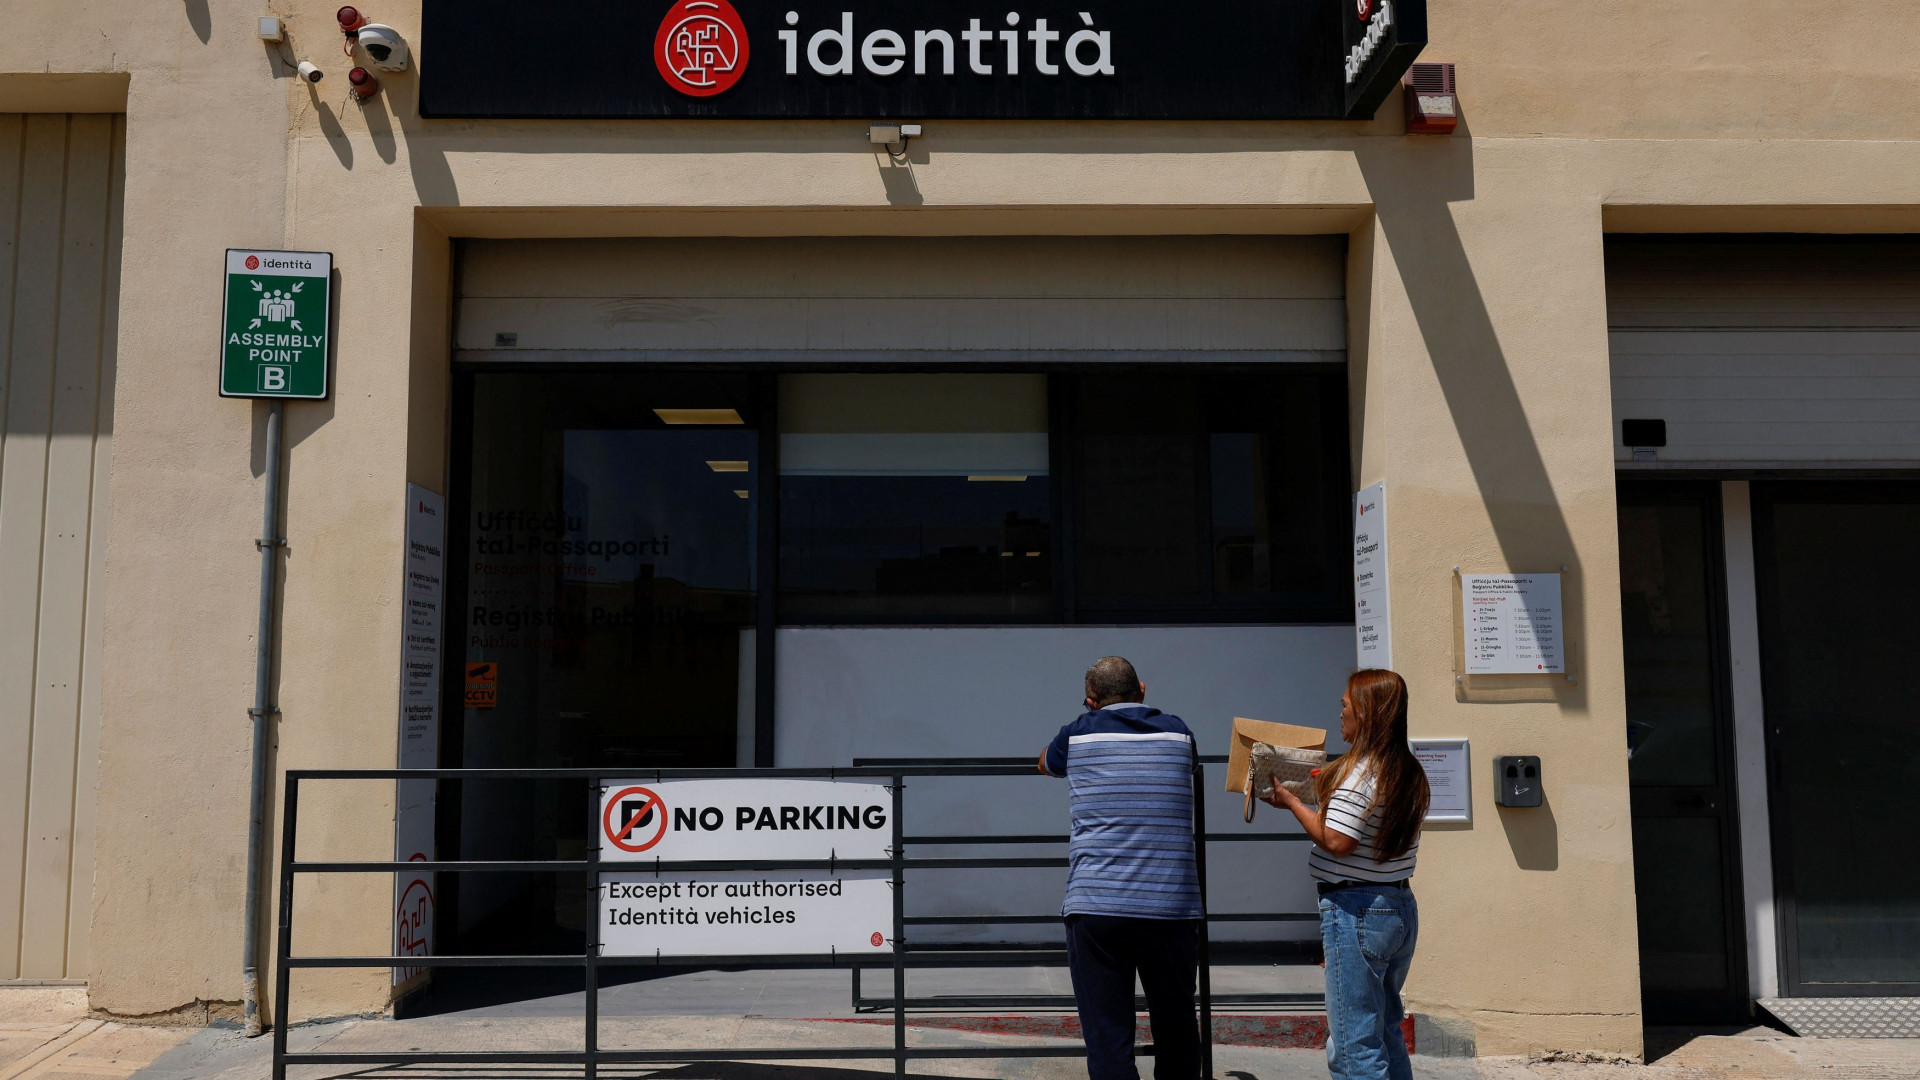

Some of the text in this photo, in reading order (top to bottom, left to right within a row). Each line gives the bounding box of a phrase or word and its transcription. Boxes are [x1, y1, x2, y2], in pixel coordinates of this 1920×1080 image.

[778, 10, 1115, 76] identità
[263, 258, 312, 270] identità
[228, 332, 323, 348] ASSEMBLY
[250, 348, 302, 363] POINT
[264, 366, 286, 390] B
[476, 535, 669, 562] tal-Passaporti
[474, 562, 541, 579] Passport
[472, 635, 519, 648] Public
[465, 691, 495, 700] CCTV
[674, 806, 724, 832] NO
[736, 804, 887, 831] PARKING
[608, 878, 842, 903] Except for authorised
[608, 906, 796, 926] Identità vehicles
